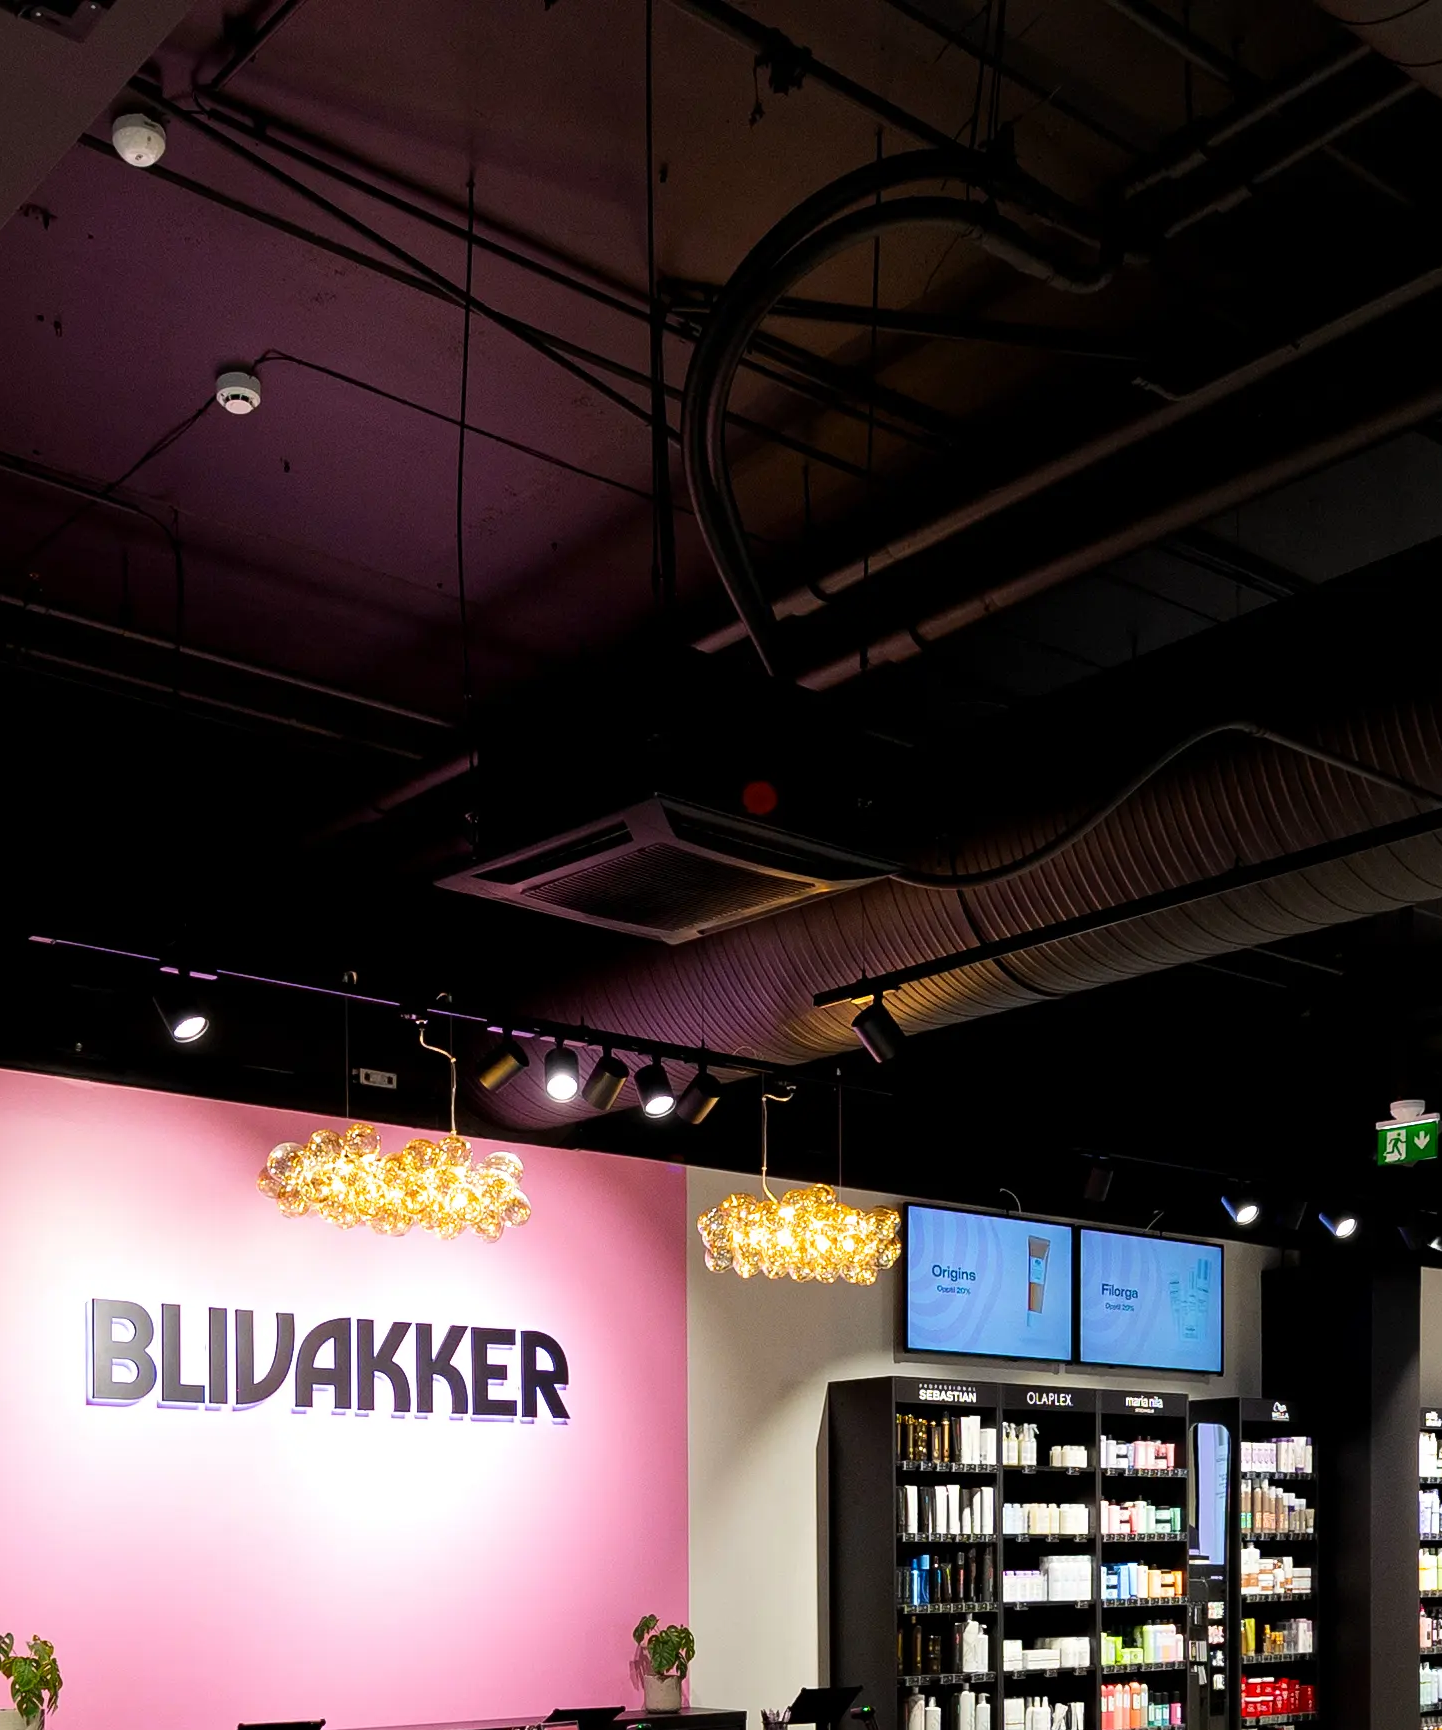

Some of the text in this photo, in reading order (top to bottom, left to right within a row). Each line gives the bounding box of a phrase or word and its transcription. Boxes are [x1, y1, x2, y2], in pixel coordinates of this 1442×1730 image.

[931, 1264, 977, 1283] Origins
[1101, 1283, 1139, 1300] Filorga
[88, 1297, 571, 1420] BLIVAKKER
[919, 1390, 976, 1403] SEBASTIAN
[1027, 1392, 1072, 1406] OLAPLEX
